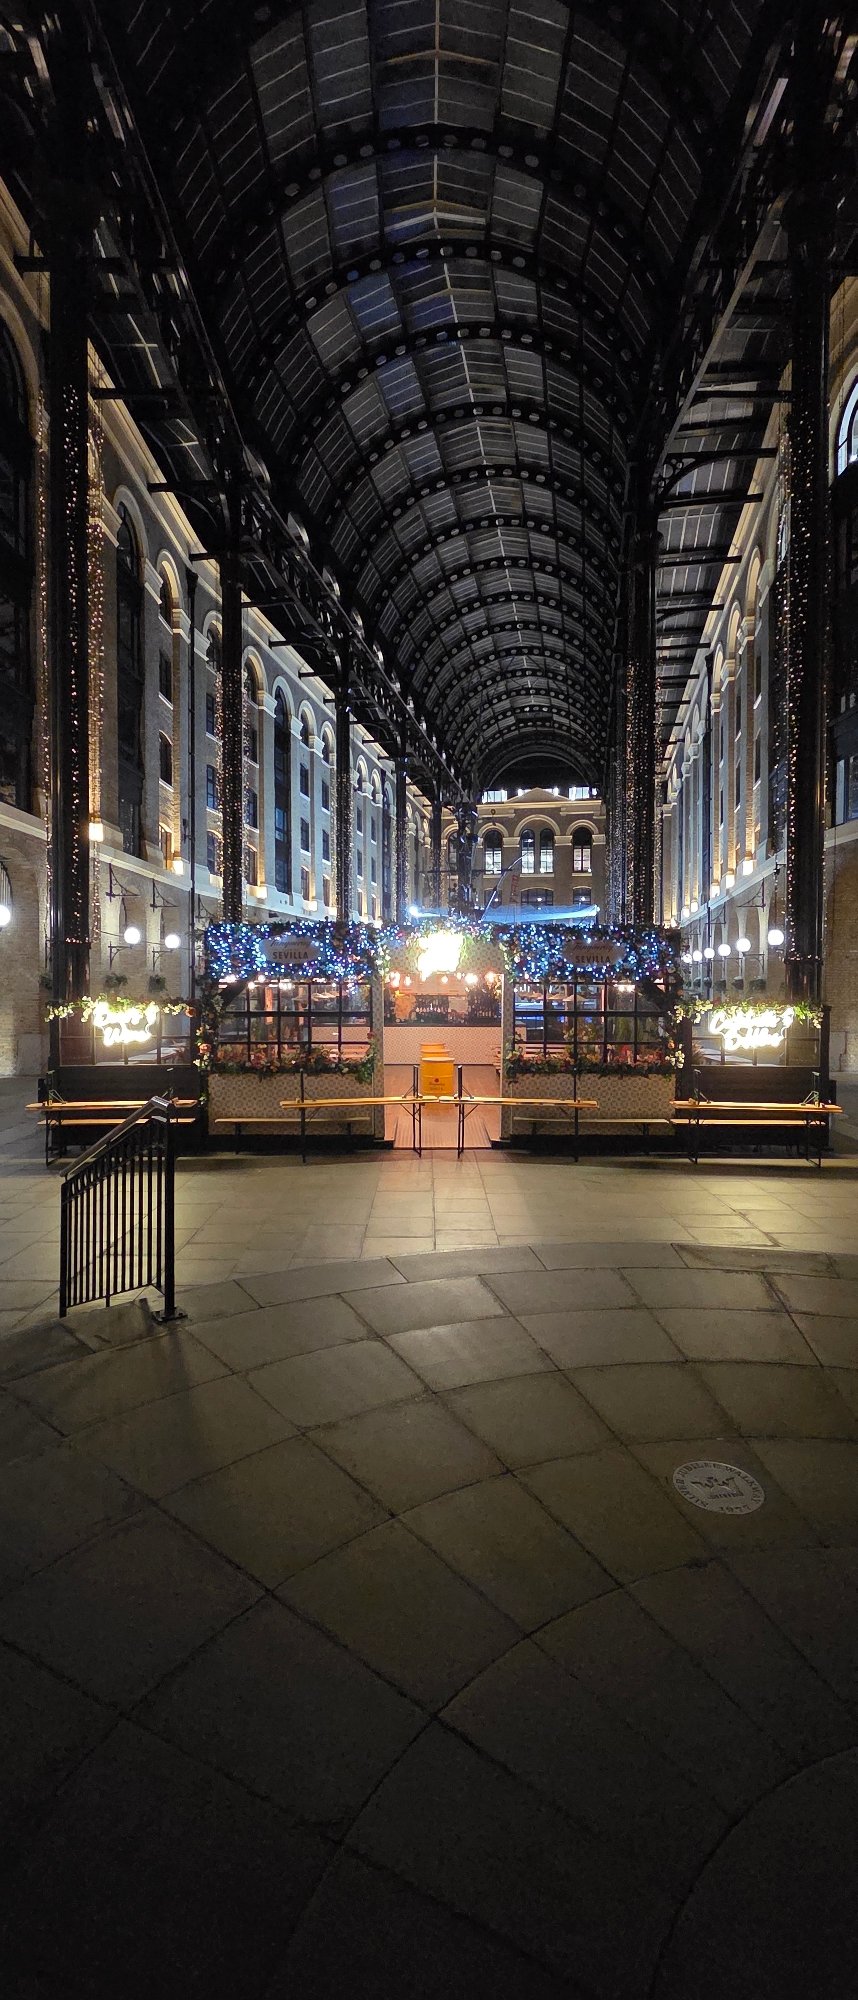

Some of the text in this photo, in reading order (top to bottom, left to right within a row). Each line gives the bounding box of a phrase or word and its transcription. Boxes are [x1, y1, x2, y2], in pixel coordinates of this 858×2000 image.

[273, 951, 308, 959] SEVILLA
[575, 955, 611, 963] SEVILLA
[676, 1462, 761, 1508] SILVER JUBILEE WALKWAY
[720, 1504, 752, 1513] 1977
